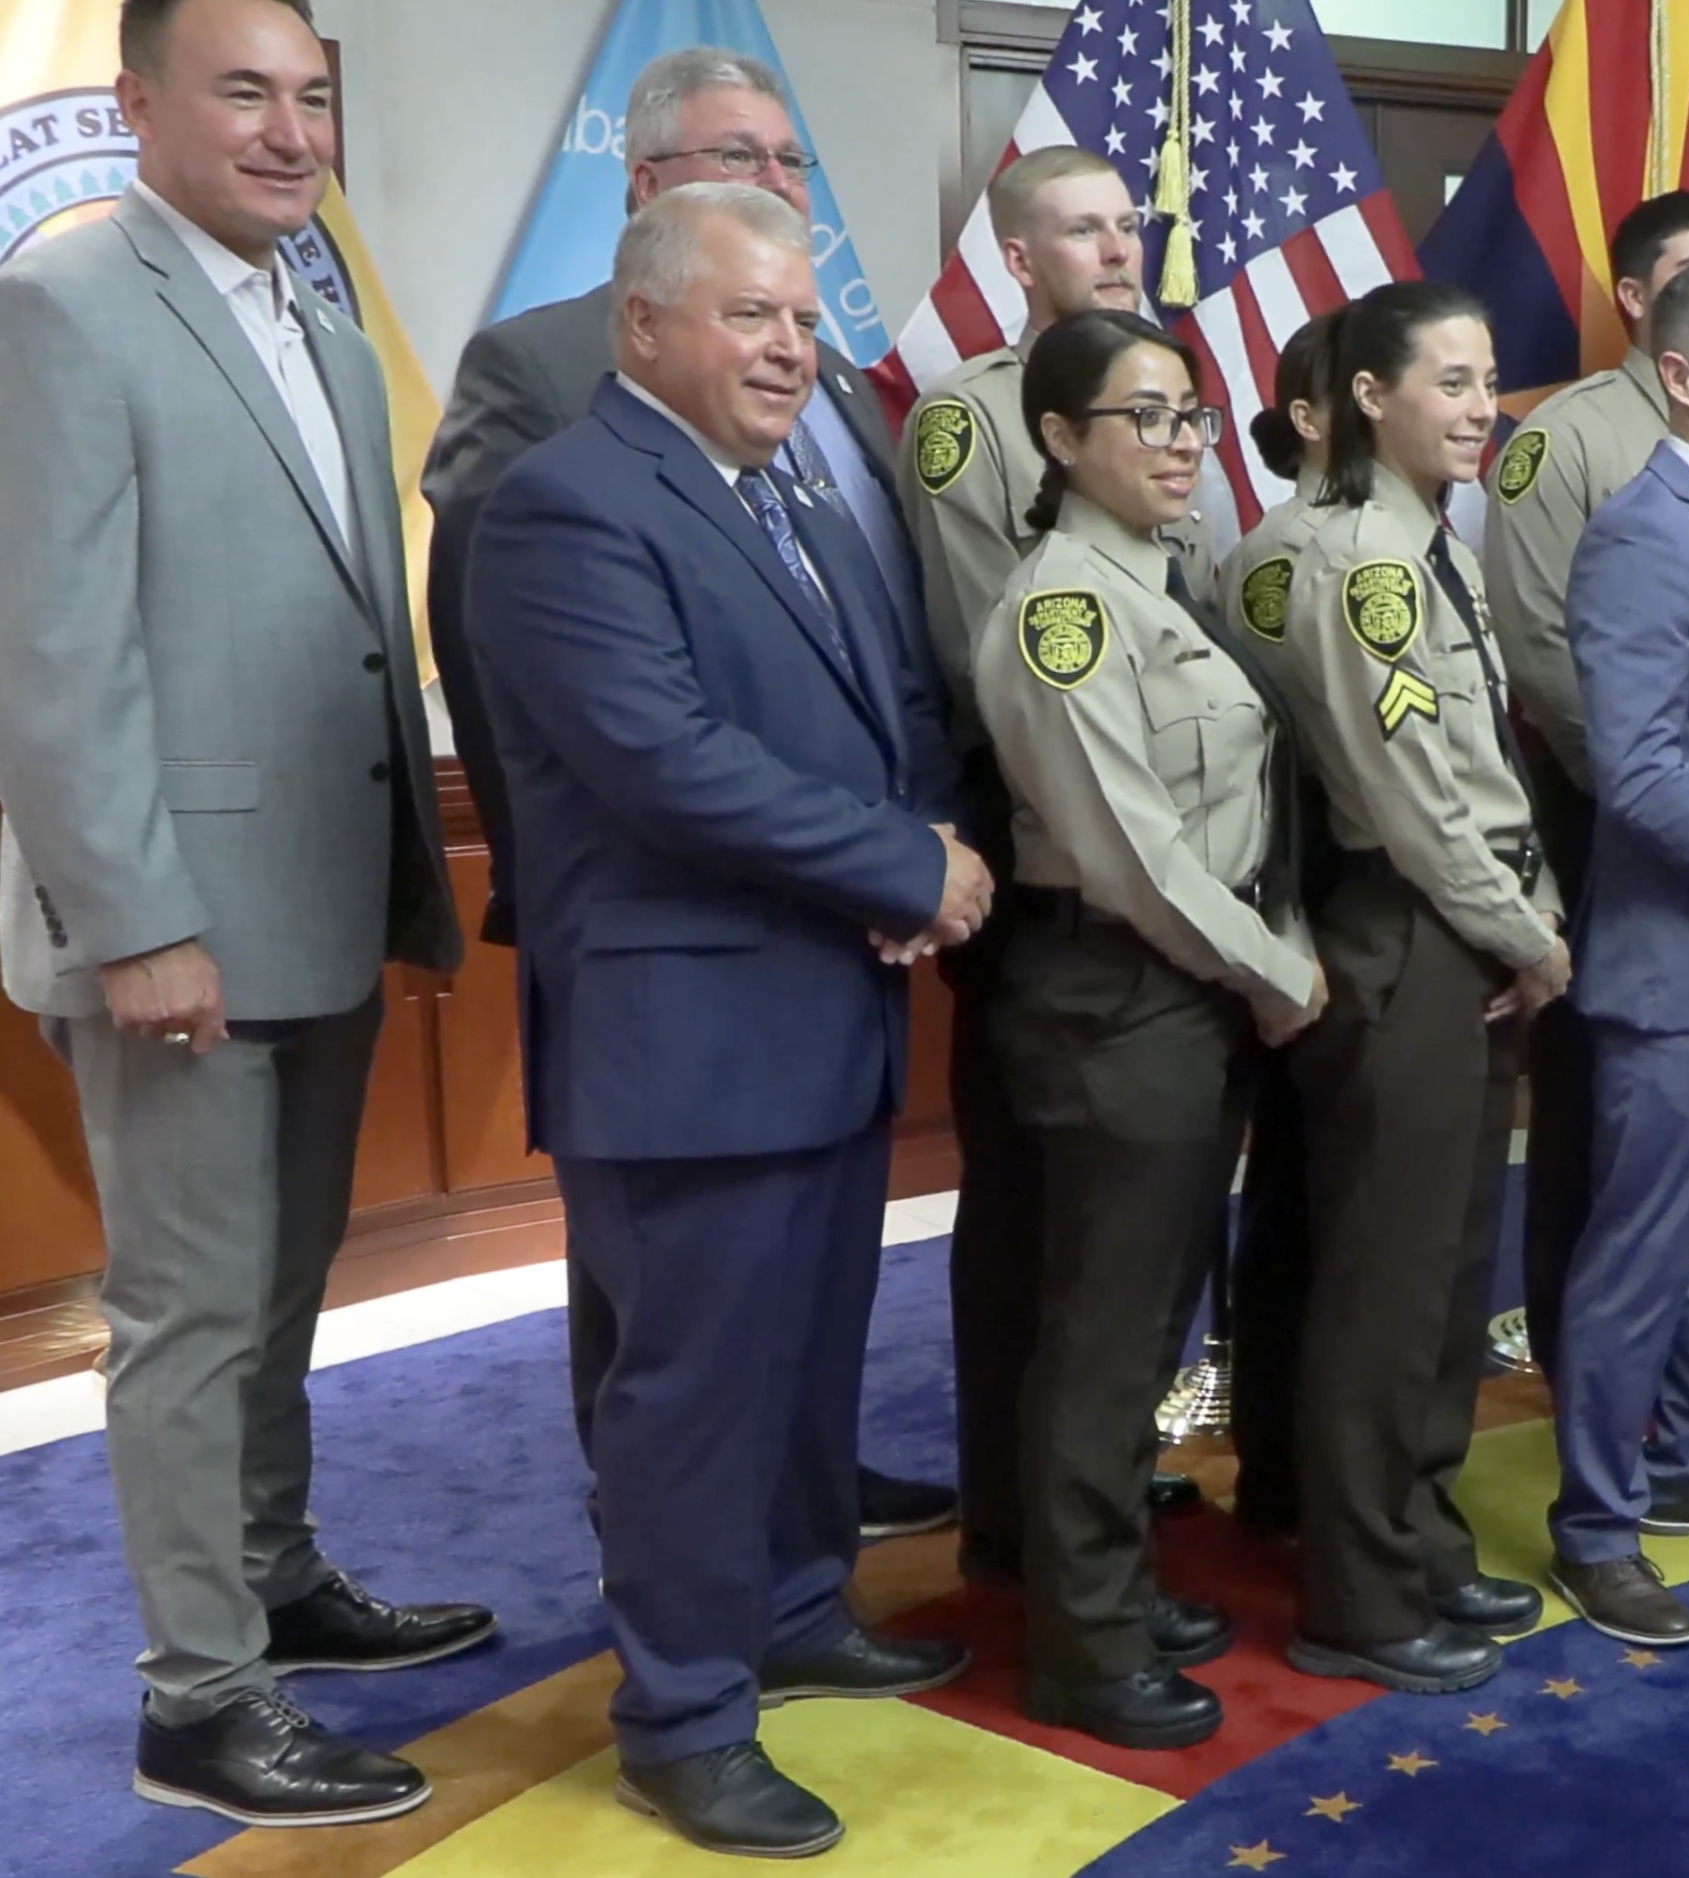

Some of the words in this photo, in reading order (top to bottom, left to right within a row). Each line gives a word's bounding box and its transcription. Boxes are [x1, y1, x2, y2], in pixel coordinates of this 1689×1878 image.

[0, 113, 60, 168] AT
[75, 107, 134, 138] SE
[1036, 597, 1088, 613] ARIZONA
